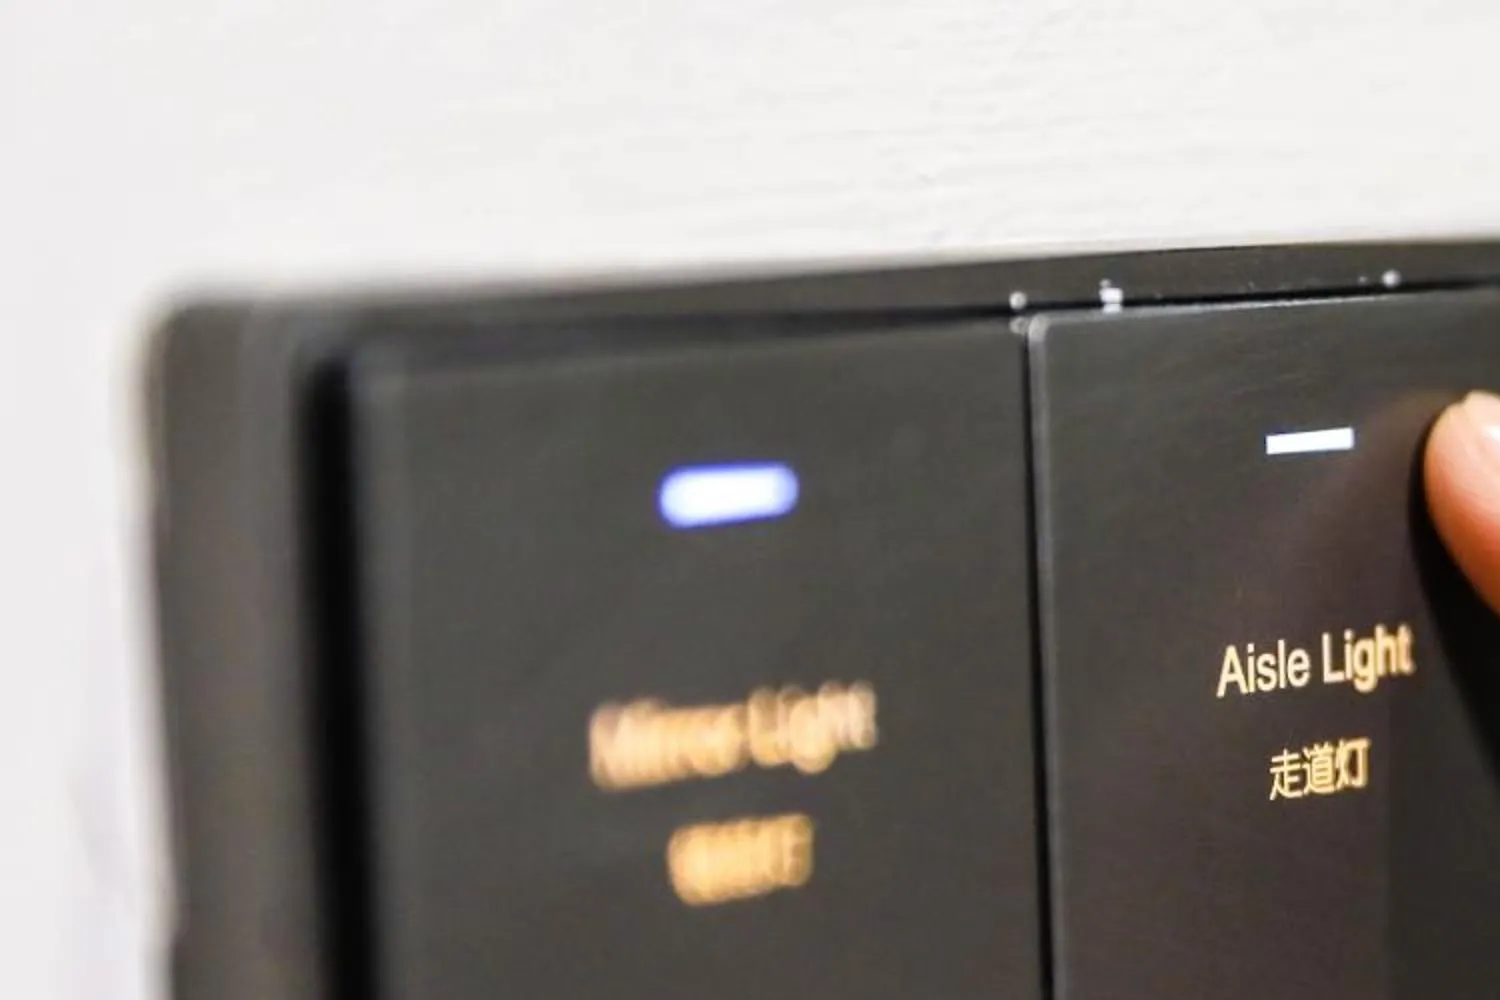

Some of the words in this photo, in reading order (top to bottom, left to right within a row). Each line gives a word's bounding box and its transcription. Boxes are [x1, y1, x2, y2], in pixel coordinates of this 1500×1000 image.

[1216, 637, 1311, 699] Aisle
[1321, 624, 1415, 693] Light
[1269, 738, 1370, 800] 走道灯
